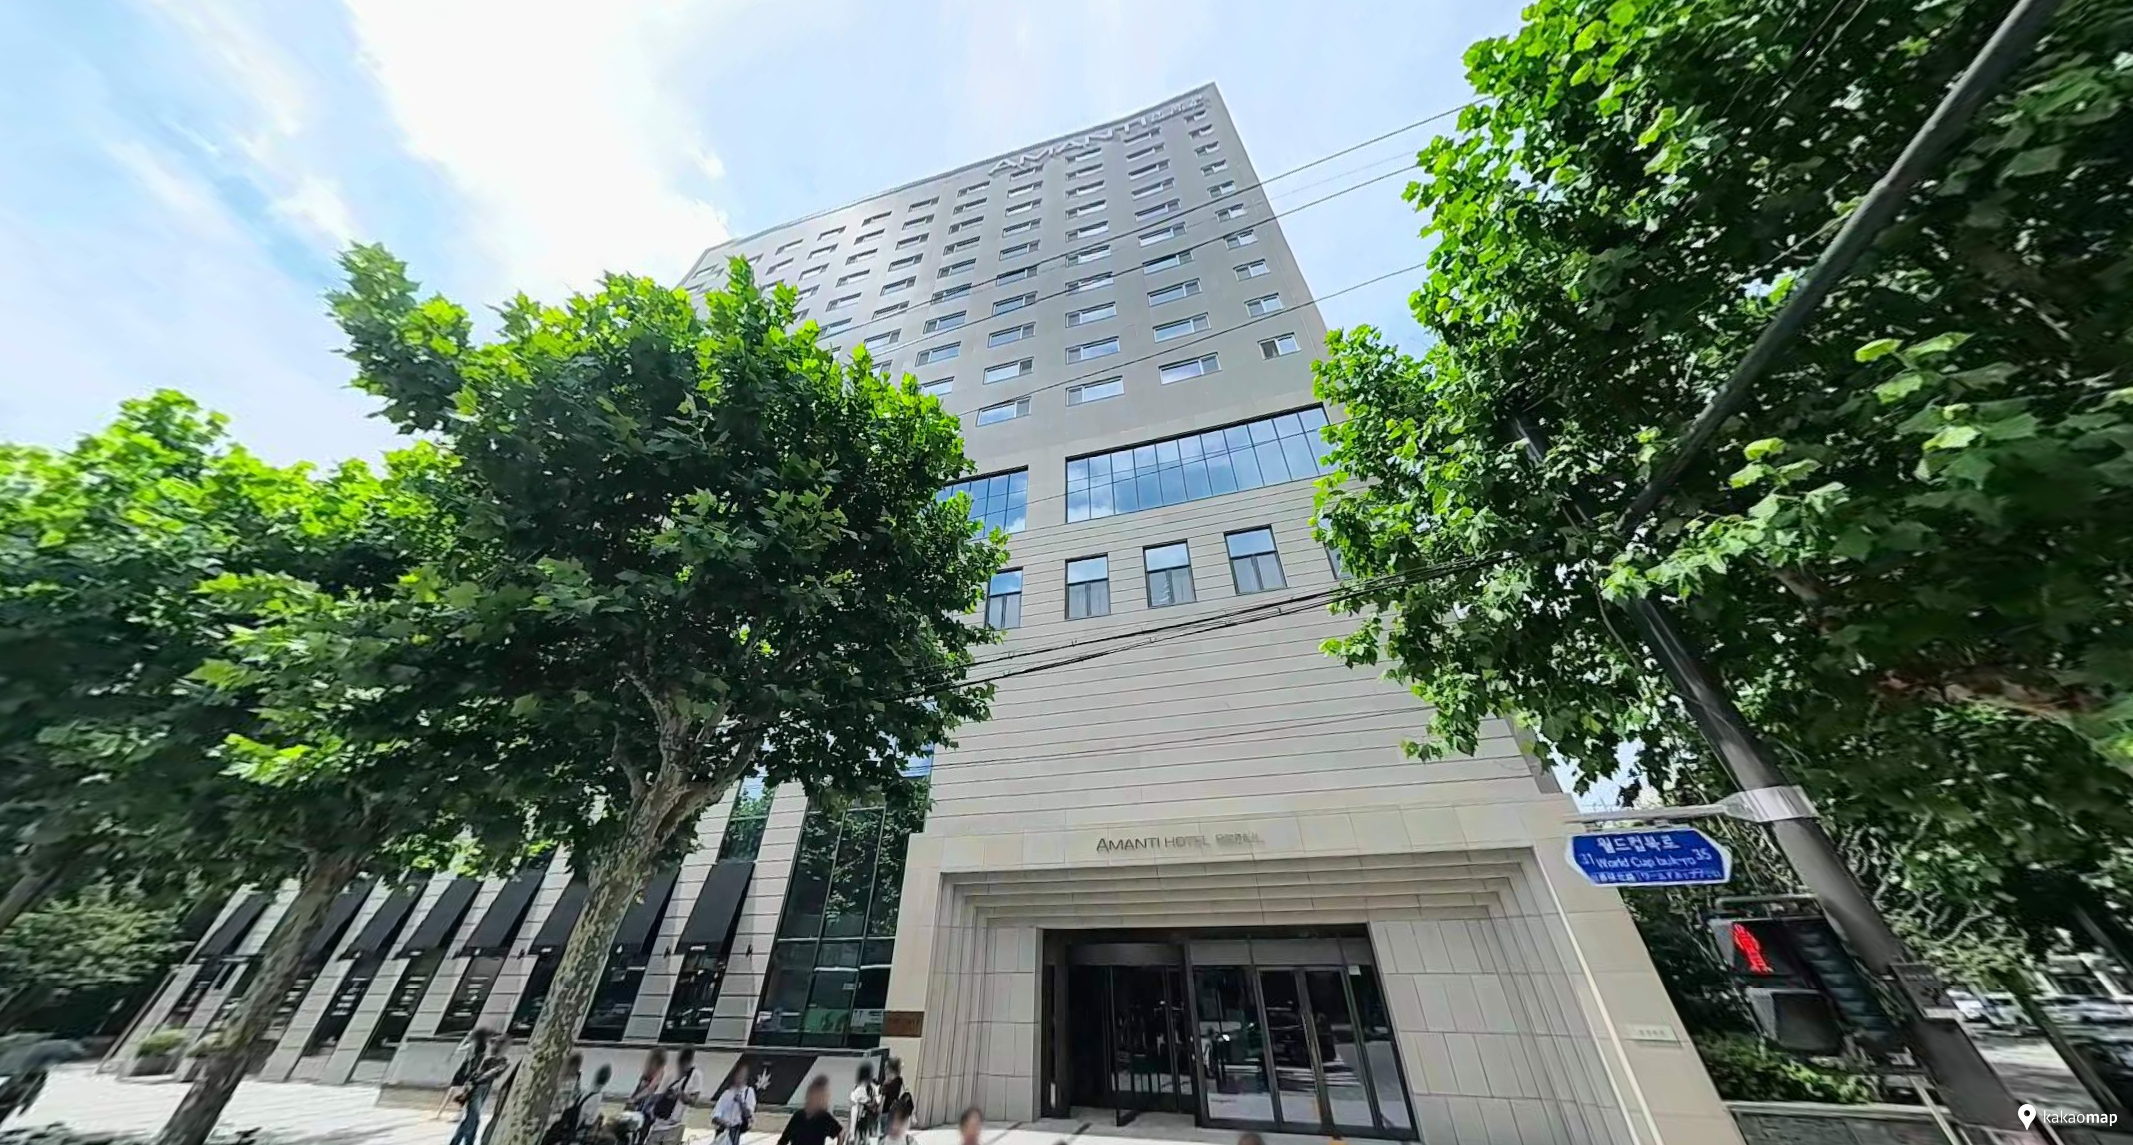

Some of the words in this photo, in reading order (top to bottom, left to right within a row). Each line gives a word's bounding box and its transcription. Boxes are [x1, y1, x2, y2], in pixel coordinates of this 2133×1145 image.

[988, 117, 1147, 175] AMANTI
[1096, 836, 1160, 853] AMANTI
[1597, 834, 1681, 854] 월드컵북로
[1579, 853, 1595, 867] 31
[1596, 857, 1629, 869] World
[1630, 856, 1655, 869] Cup
[1692, 848, 1713, 861] 35
